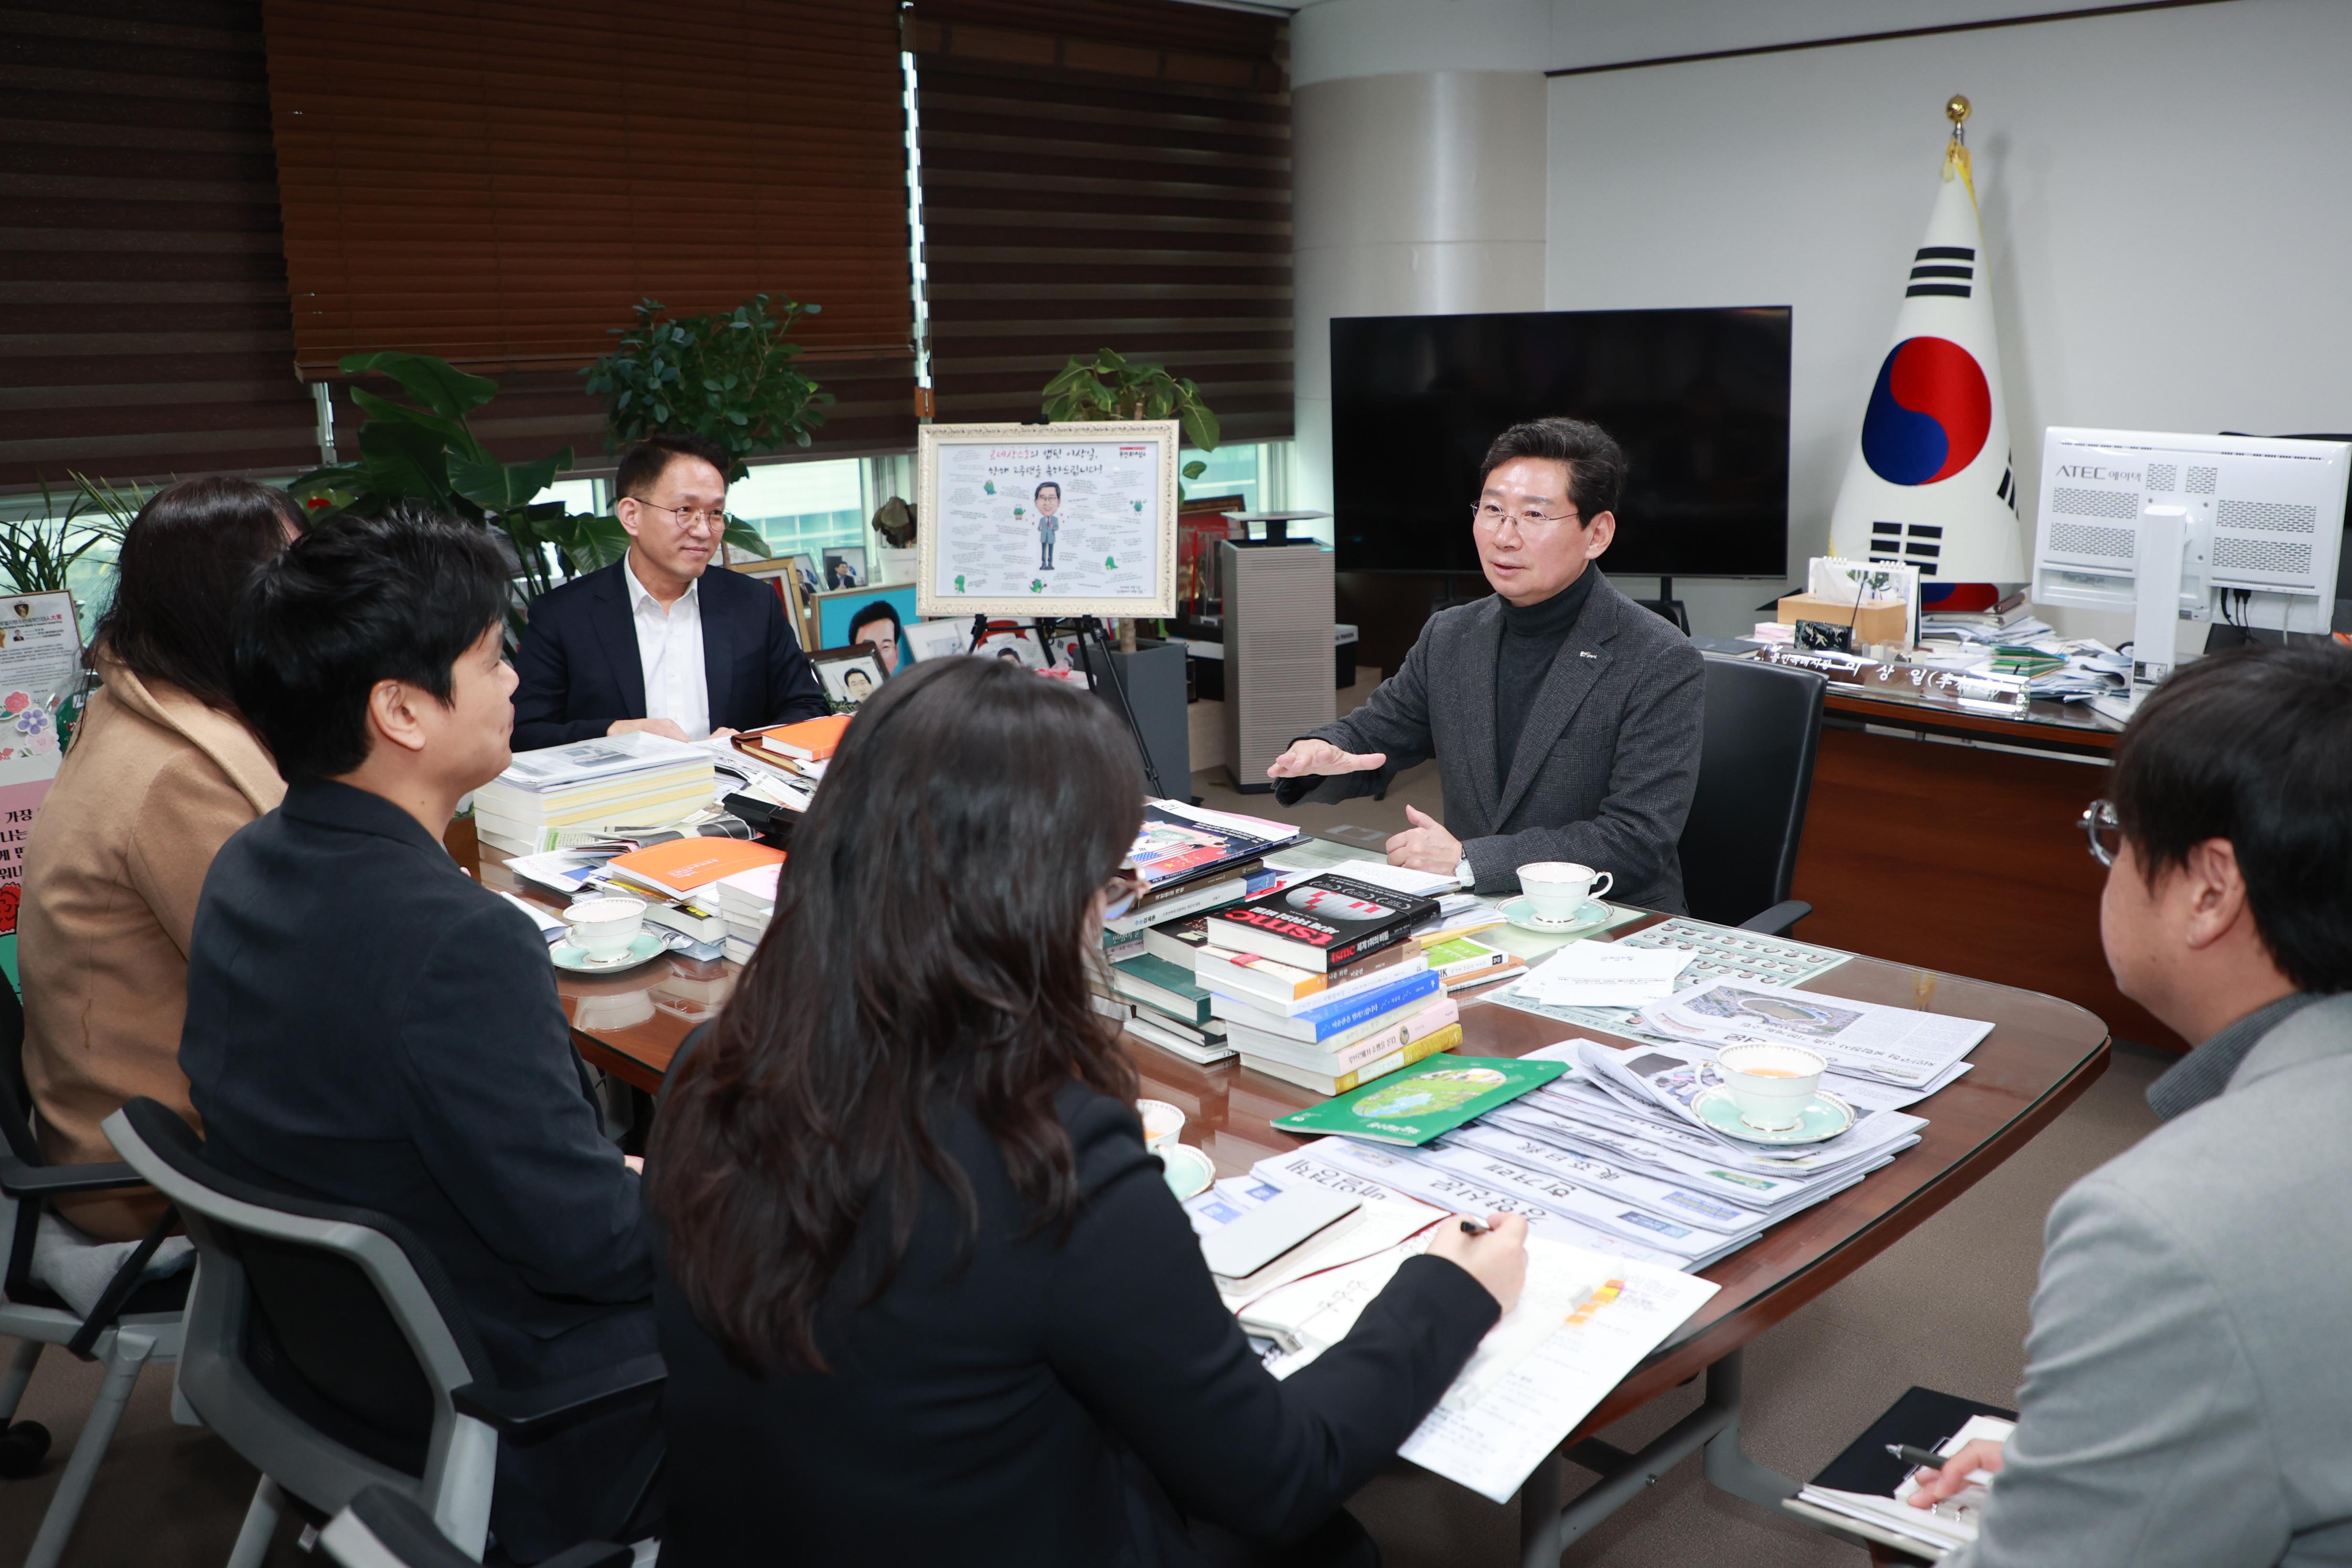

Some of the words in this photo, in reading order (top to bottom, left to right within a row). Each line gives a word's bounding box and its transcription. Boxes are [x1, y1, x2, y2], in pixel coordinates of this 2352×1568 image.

[2056, 464, 2107, 480] ATEC
[1876, 664, 1895, 682] 상
[4, 809, 33, 824] 가장
[1134, 916, 1156, 926] 수소경제론
[1225, 909, 1334, 945] tsmc
[1330, 945, 1356, 964] tsmc
[1356, 941, 1367, 953] 세계
[1367, 935, 1380, 950] 1위의
[1379, 930, 1390, 945] 비밀
[1483, 1163, 1578, 1199] 한겨레
